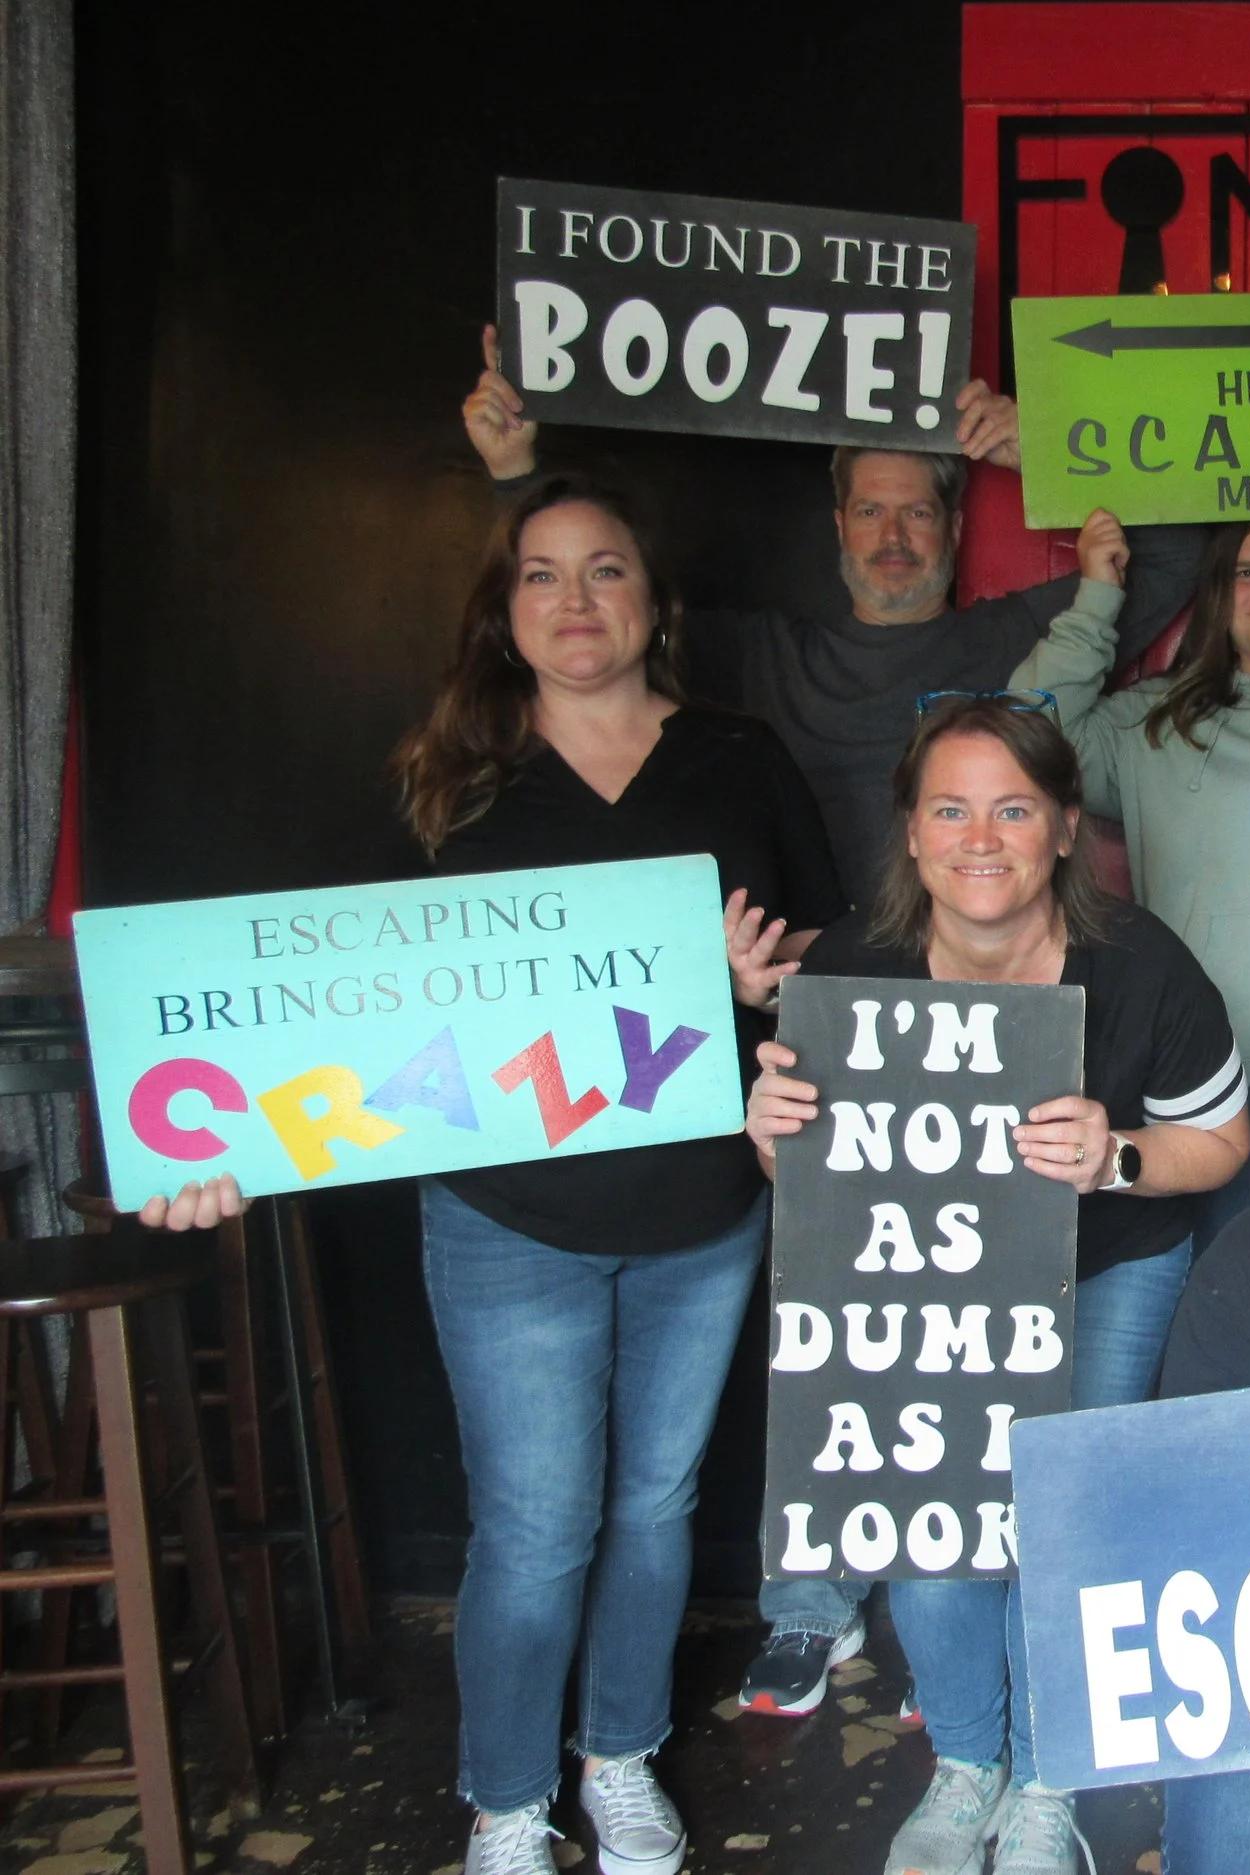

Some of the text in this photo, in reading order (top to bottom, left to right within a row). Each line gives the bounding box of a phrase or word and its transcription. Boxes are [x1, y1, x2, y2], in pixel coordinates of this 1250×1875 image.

[515, 206, 953, 292] I FOUND THE
[514, 280, 951, 430] BOOZE!
[247, 890, 570, 960] ESCAPING
[157, 945, 664, 1036] BRINGS OUT MY
[846, 1000, 1003, 1073] I'M
[128, 1004, 712, 1183] CRAZY
[826, 1101, 1020, 1174] NOT
[854, 1203, 984, 1274] AS
[771, 1302, 1064, 1373] DUMB
[812, 1402, 946, 1472] AS
